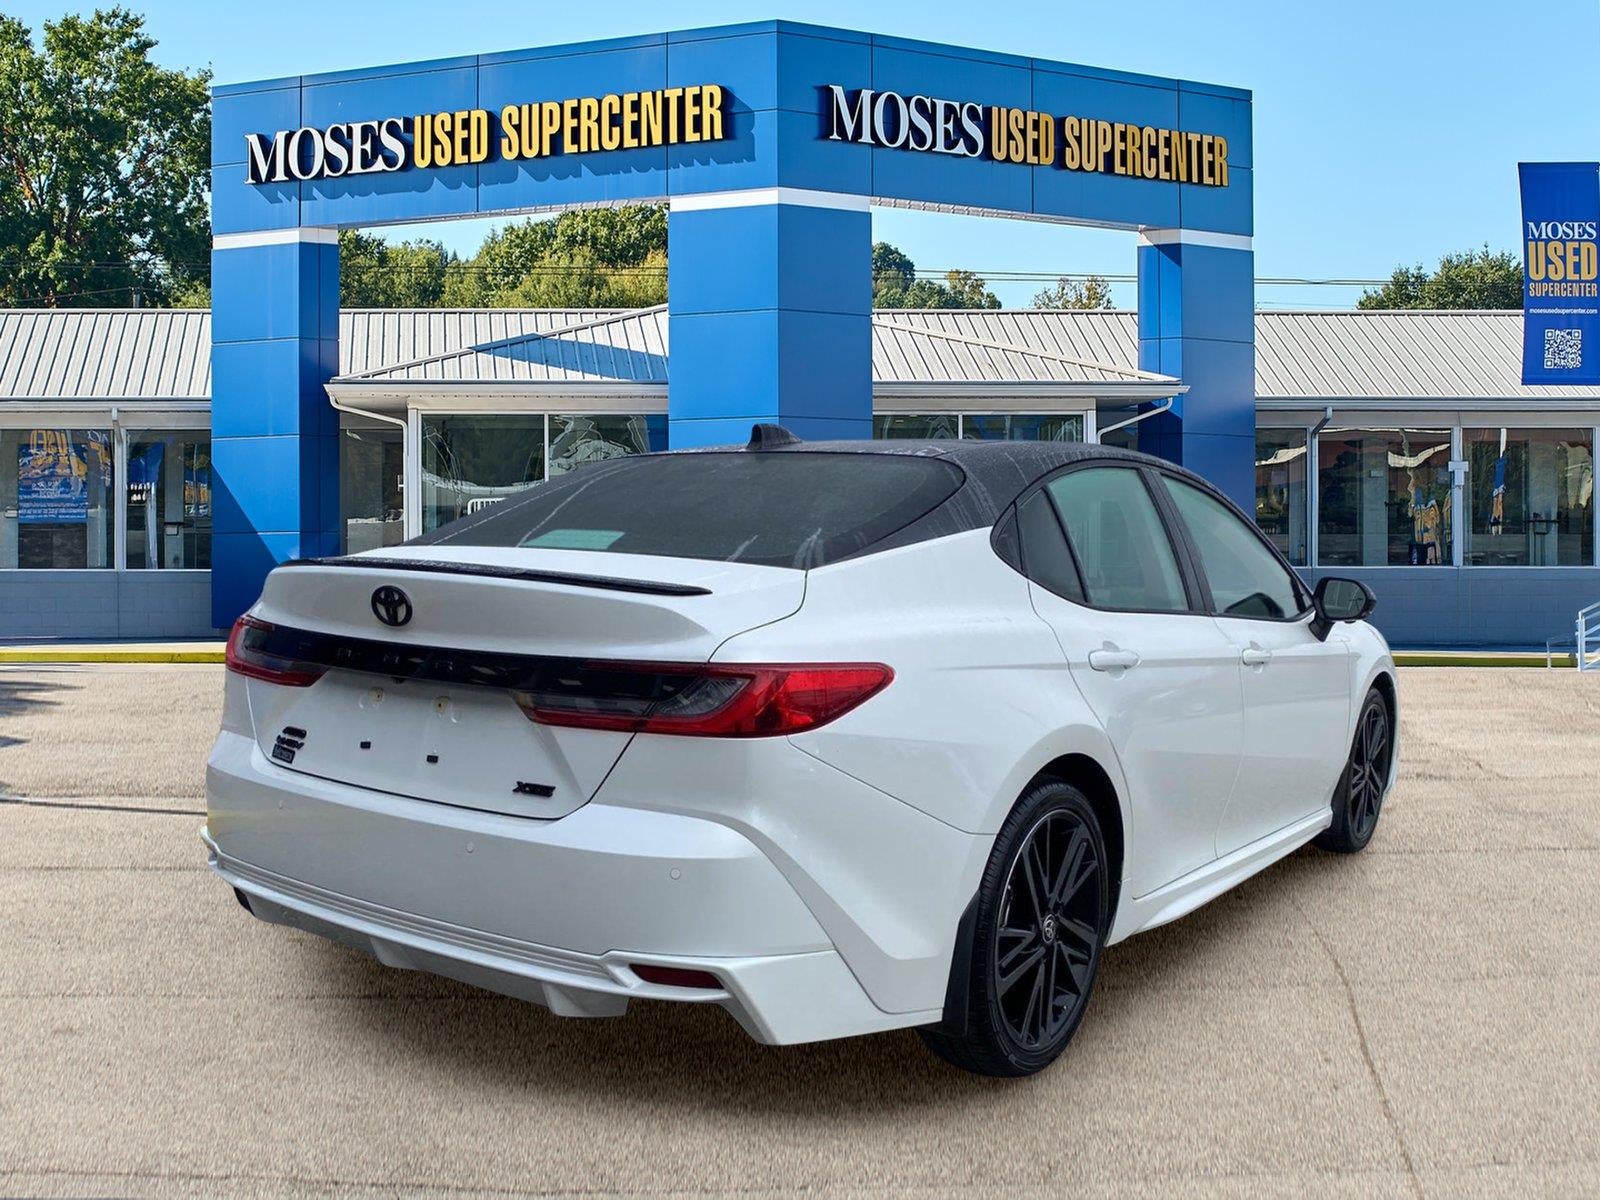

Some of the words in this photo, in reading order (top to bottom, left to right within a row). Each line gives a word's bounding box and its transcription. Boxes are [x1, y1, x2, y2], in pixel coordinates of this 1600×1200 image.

[244, 117, 409, 185] MOSES
[413, 108, 488, 169] USED
[500, 84, 723, 162] SUPERCENTER
[828, 84, 985, 158] MOSES
[991, 106, 1055, 167] USED
[1064, 115, 1229, 187] SUPERCENTER
[1527, 221, 1597, 240] MOSES
[1528, 241, 1598, 281] USED
[1529, 282, 1598, 297] SUPERCENTER
